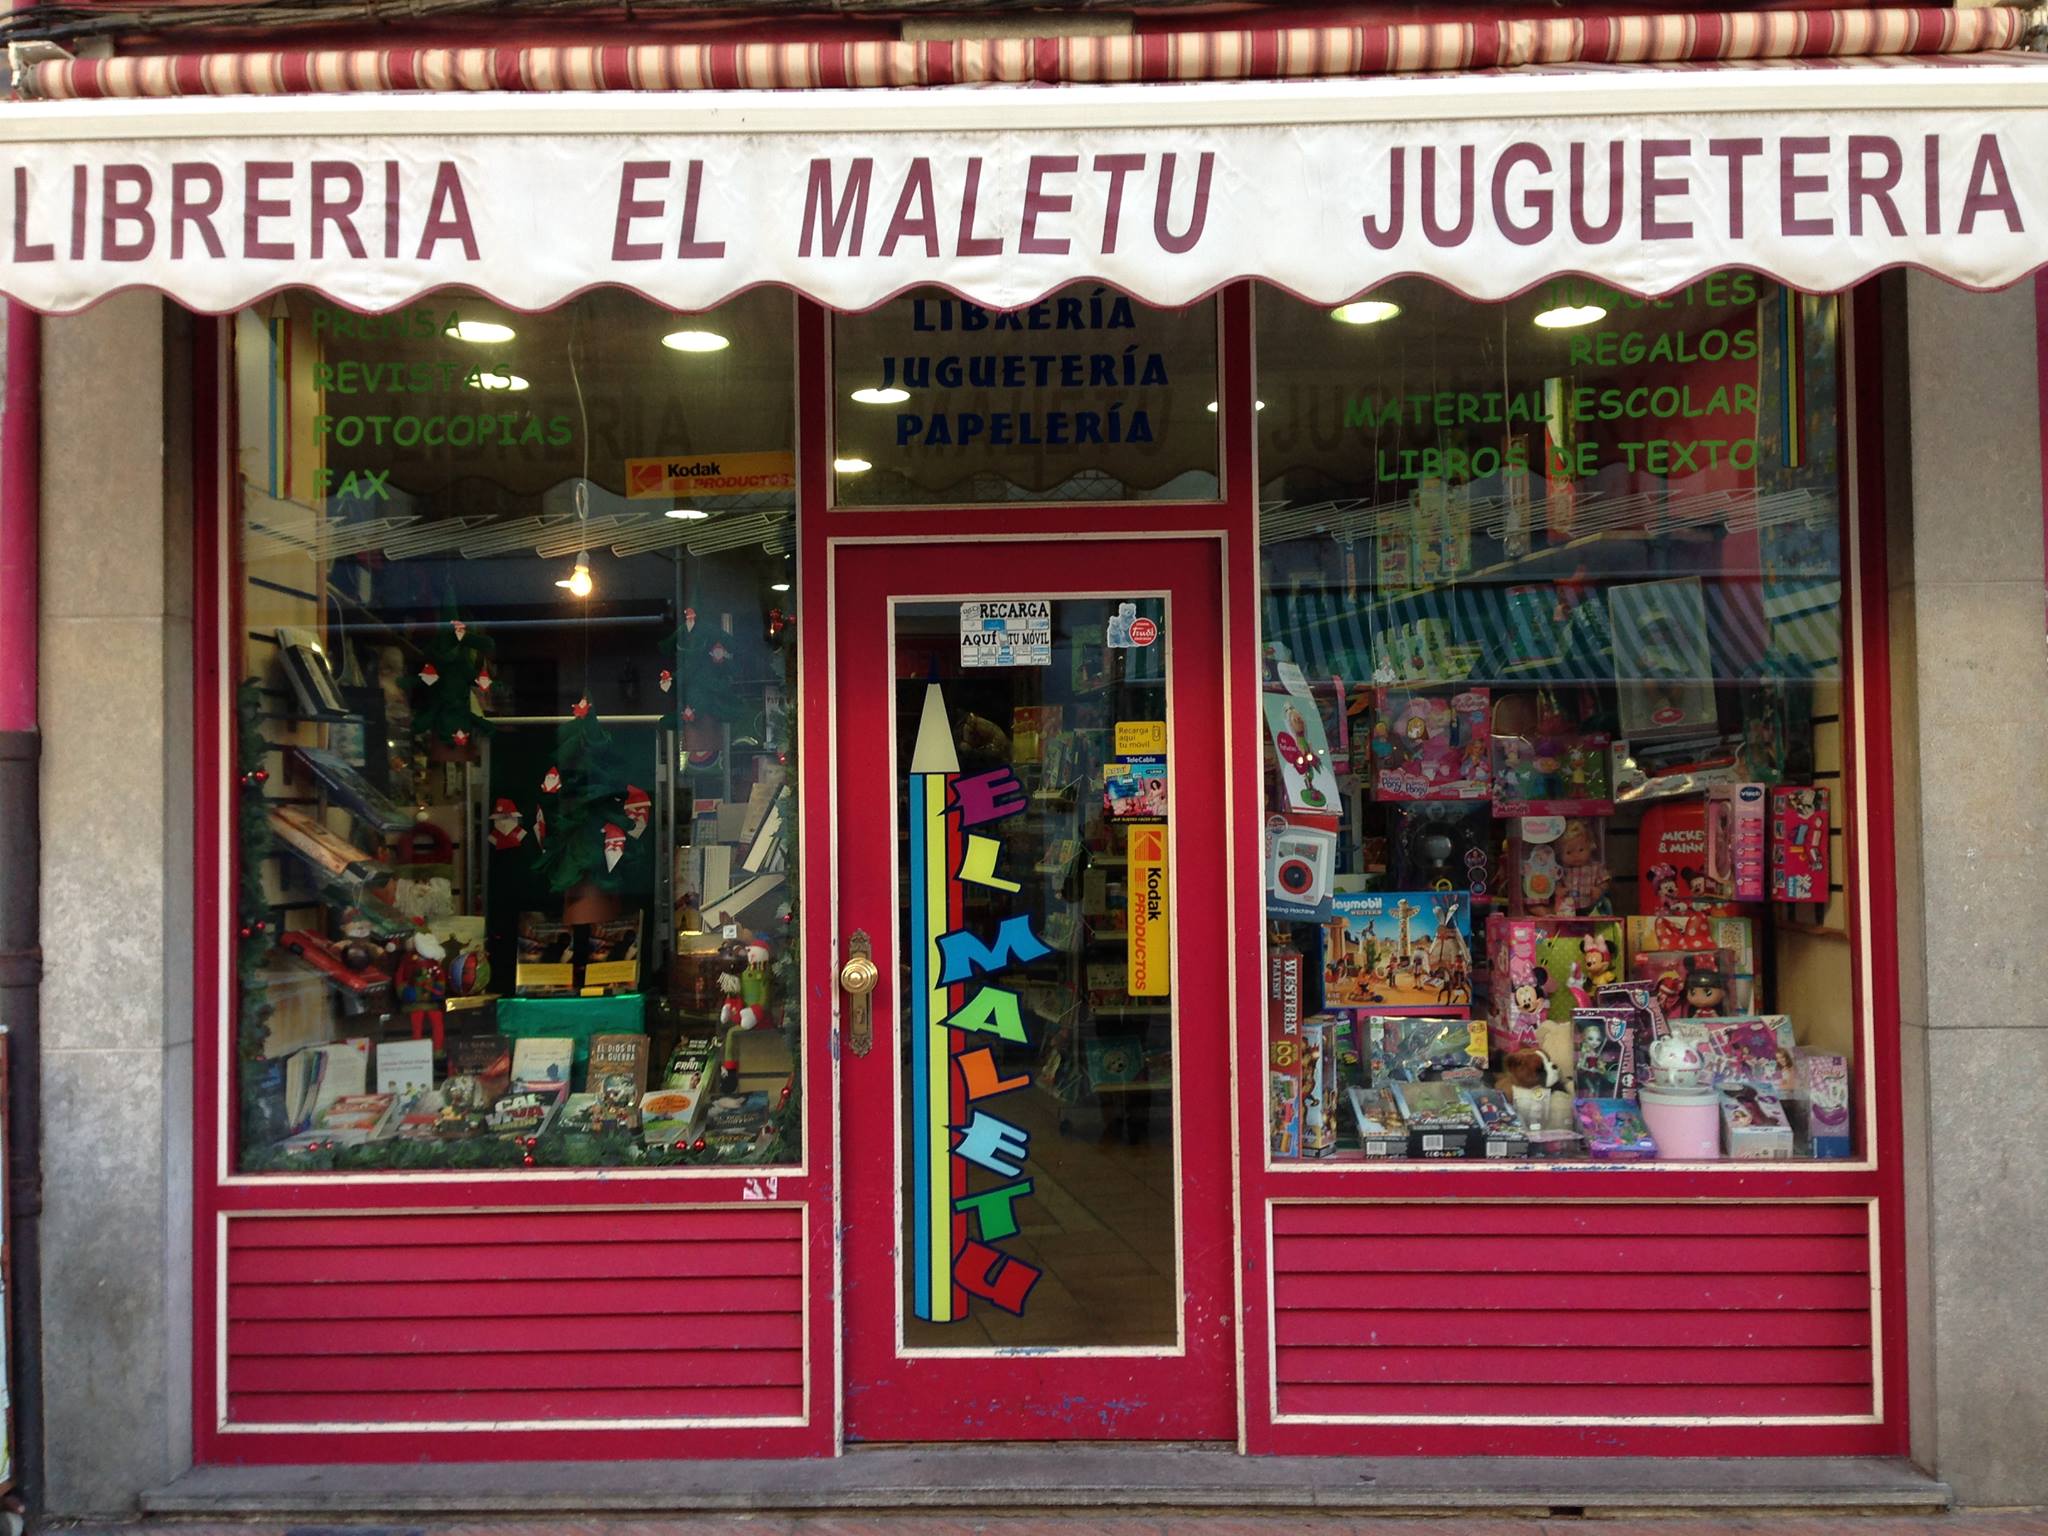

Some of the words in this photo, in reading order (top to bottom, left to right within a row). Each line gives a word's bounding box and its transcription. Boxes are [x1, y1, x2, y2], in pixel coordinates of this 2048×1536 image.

[12, 160, 481, 263] LIBRERIA
[611, 159, 726, 262] EL
[798, 151, 1215, 259] MALETU
[1362, 132, 2026, 250] JUGUETERIA
[1568, 327, 1759, 366] REGALOS
[311, 361, 514, 394] REVISTAS
[876, 344, 1170, 392] JUGUETERÍA
[1344, 391, 1555, 428] MATERIAL
[1573, 382, 1760, 422] ESCOLAR
[311, 415, 574, 448] FOTOCOPIAS
[895, 402, 1155, 447] PAPELERÍA
[667, 462, 722, 478] Kodak
[1377, 446, 1528, 482] LIBROS
[1549, 441, 1601, 477] DE
[1618, 437, 1759, 473] TEXTO
[311, 469, 391, 501] FAX
[692, 472, 791, 490] PRODUCTOS
[979, 602, 1049, 618] RECARGA
[962, 630, 997, 646] AQUÍ
[1008, 632, 1020, 646] TU
[1022, 630, 1050, 646] MÓVIL
[1118, 727, 1149, 736] Recarga
[1126, 756, 1156, 764] TeleCable
[1661, 830, 1705, 841] MICKE
[1669, 842, 1704, 853] MINN
[1147, 867, 1162, 921] Kodak
[1332, 897, 1383, 912] laymobil
[1133, 892, 1146, 991] PRODUCTOS
[1283, 959, 1298, 1035] WESTERN
